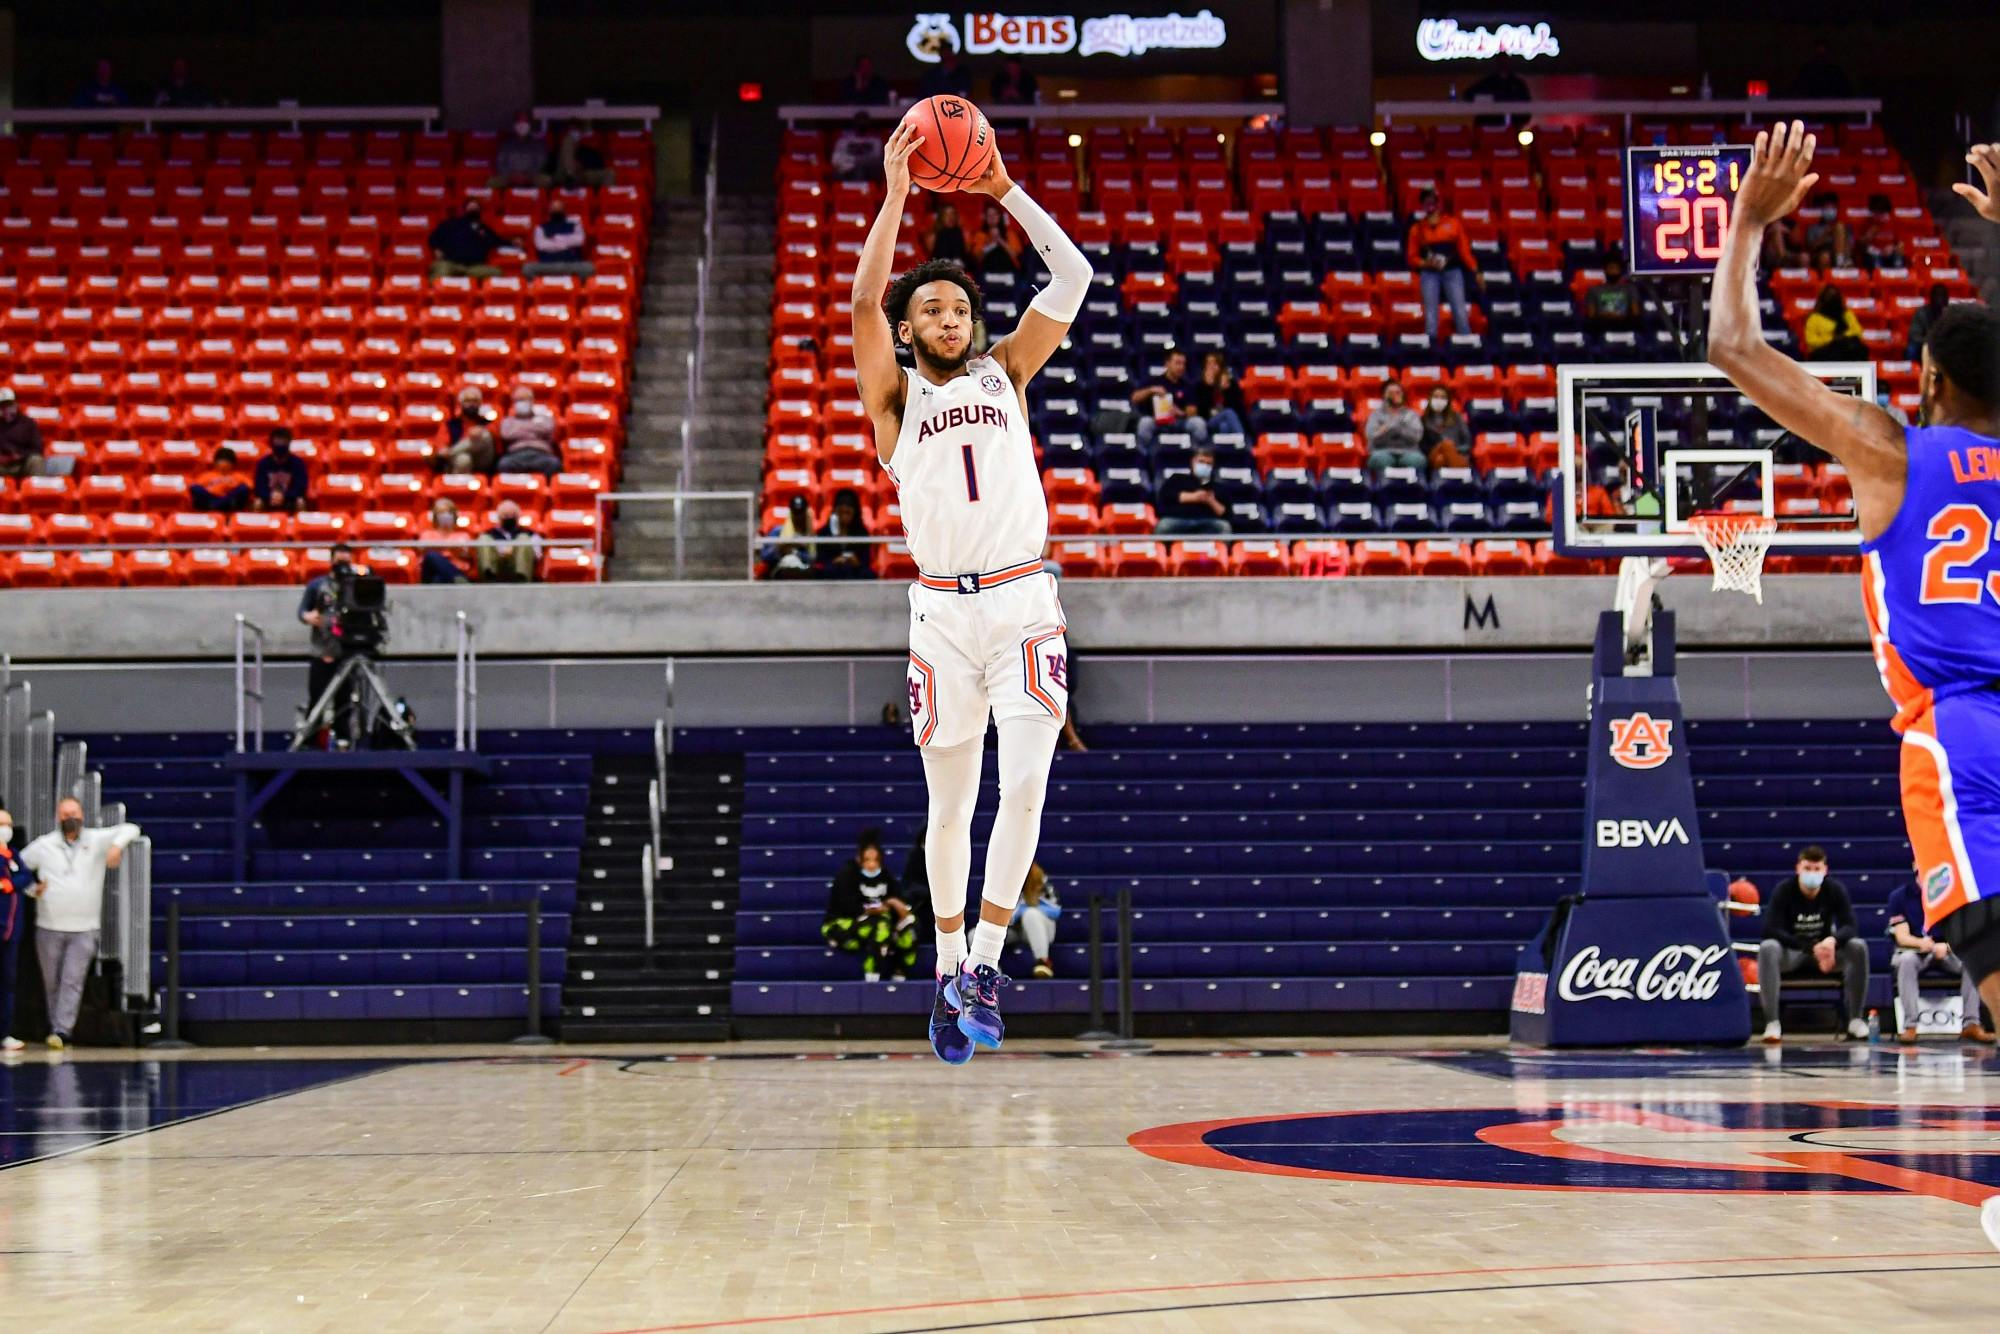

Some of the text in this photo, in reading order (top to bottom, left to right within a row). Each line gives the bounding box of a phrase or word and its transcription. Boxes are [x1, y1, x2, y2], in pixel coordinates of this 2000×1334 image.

[972, 12, 1070, 46] Bens
[1134, 15, 1223, 49] pretzels
[1654, 160, 1739, 194] 15:21
[1655, 197, 1728, 260] 20
[918, 405, 1008, 444] AUBURN
[961, 444, 980, 502] 1
[1463, 592, 1500, 630] M
[1596, 817, 1689, 848] BBVA
[1558, 945, 1640, 1002] Coca
[1636, 944, 1729, 1001] Cola
